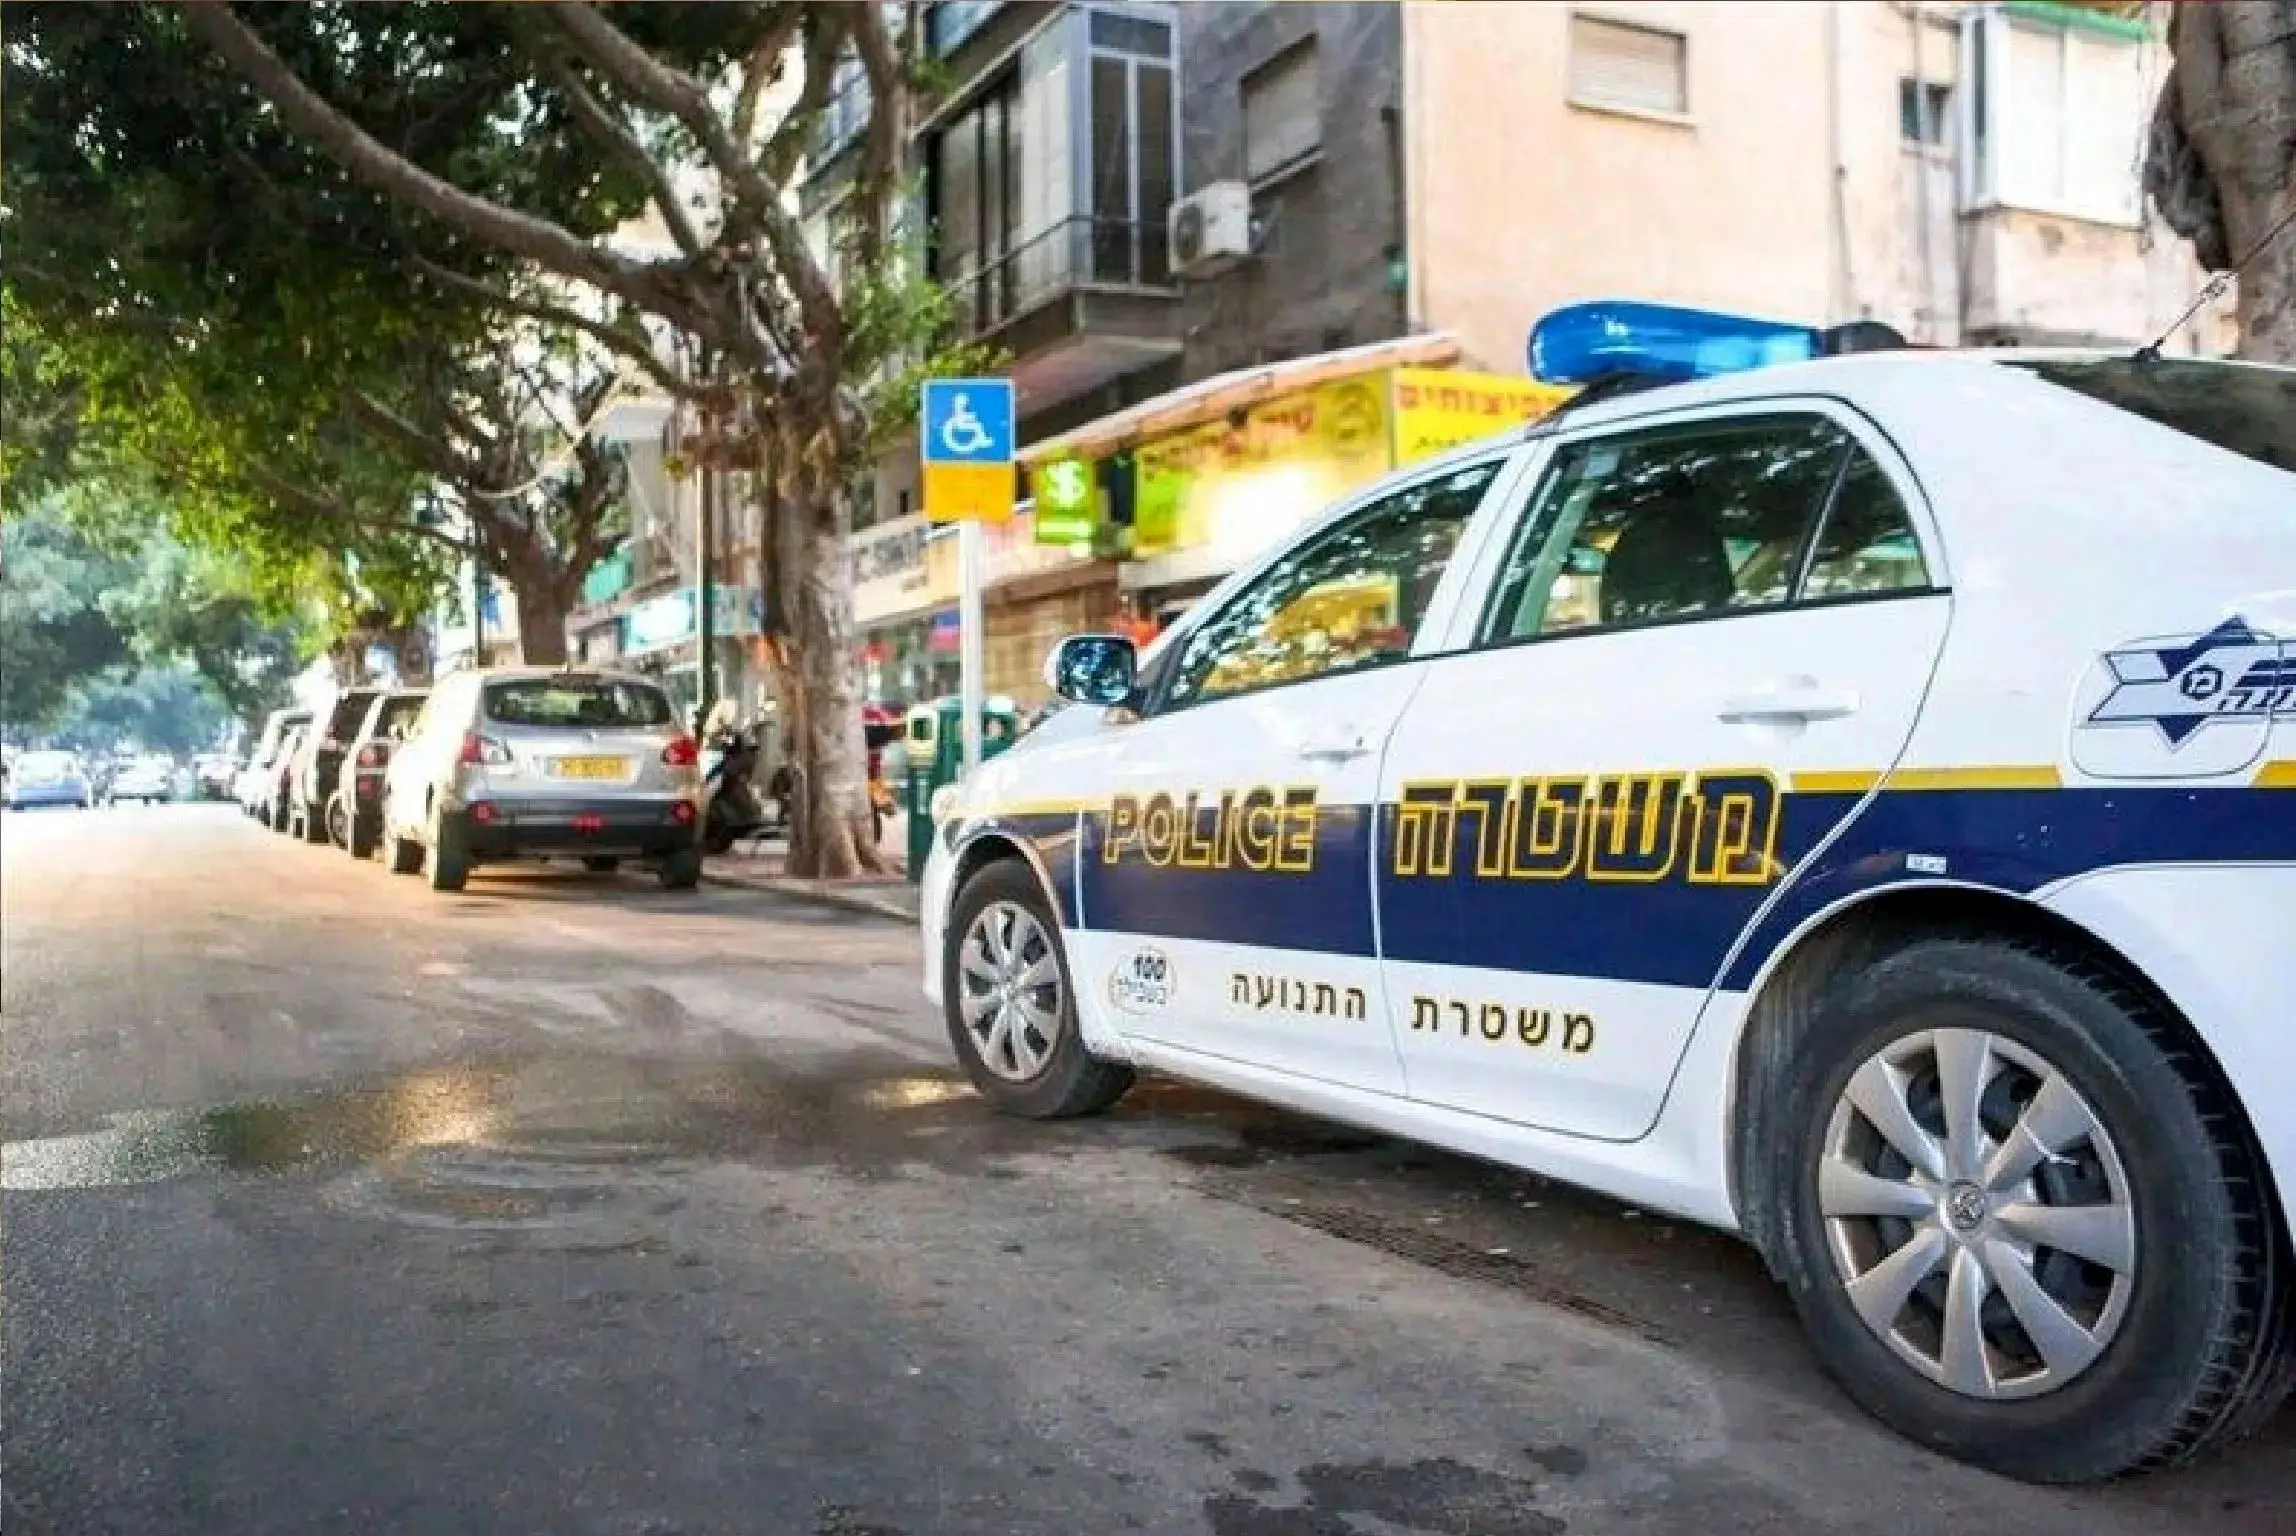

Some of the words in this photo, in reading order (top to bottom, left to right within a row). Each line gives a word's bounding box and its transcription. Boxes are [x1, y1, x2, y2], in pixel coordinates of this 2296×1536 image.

[1103, 785, 1319, 872] POLICE
[1394, 766, 1782, 885] משטרה
[1133, 954, 1168, 983] 100
[1231, 973, 1367, 1021] התנועה
[1411, 996, 1594, 1053] משטרת
